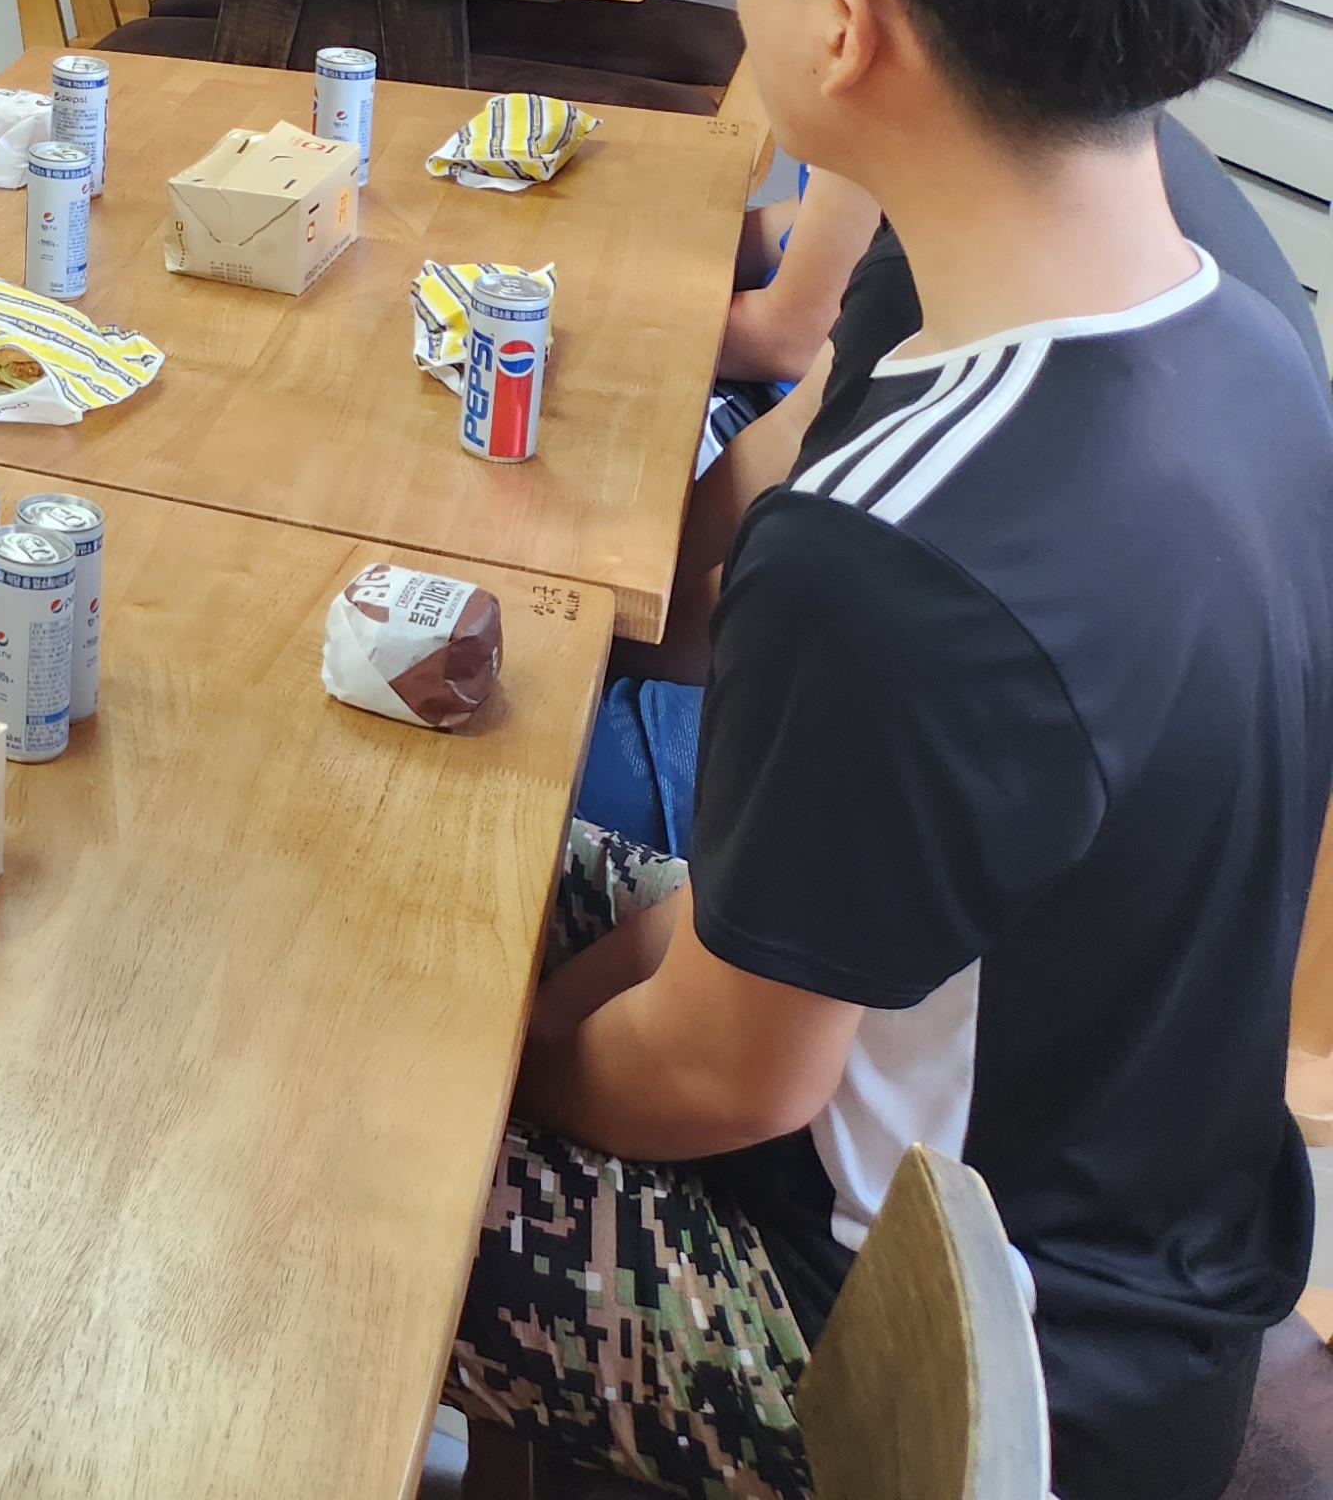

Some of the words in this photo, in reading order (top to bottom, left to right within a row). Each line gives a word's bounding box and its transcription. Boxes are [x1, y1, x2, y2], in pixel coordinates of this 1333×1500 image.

[61, 93, 88, 104] pepsi
[464, 329, 495, 448] PEPSI
[564, 589, 581, 621] GALLERY
